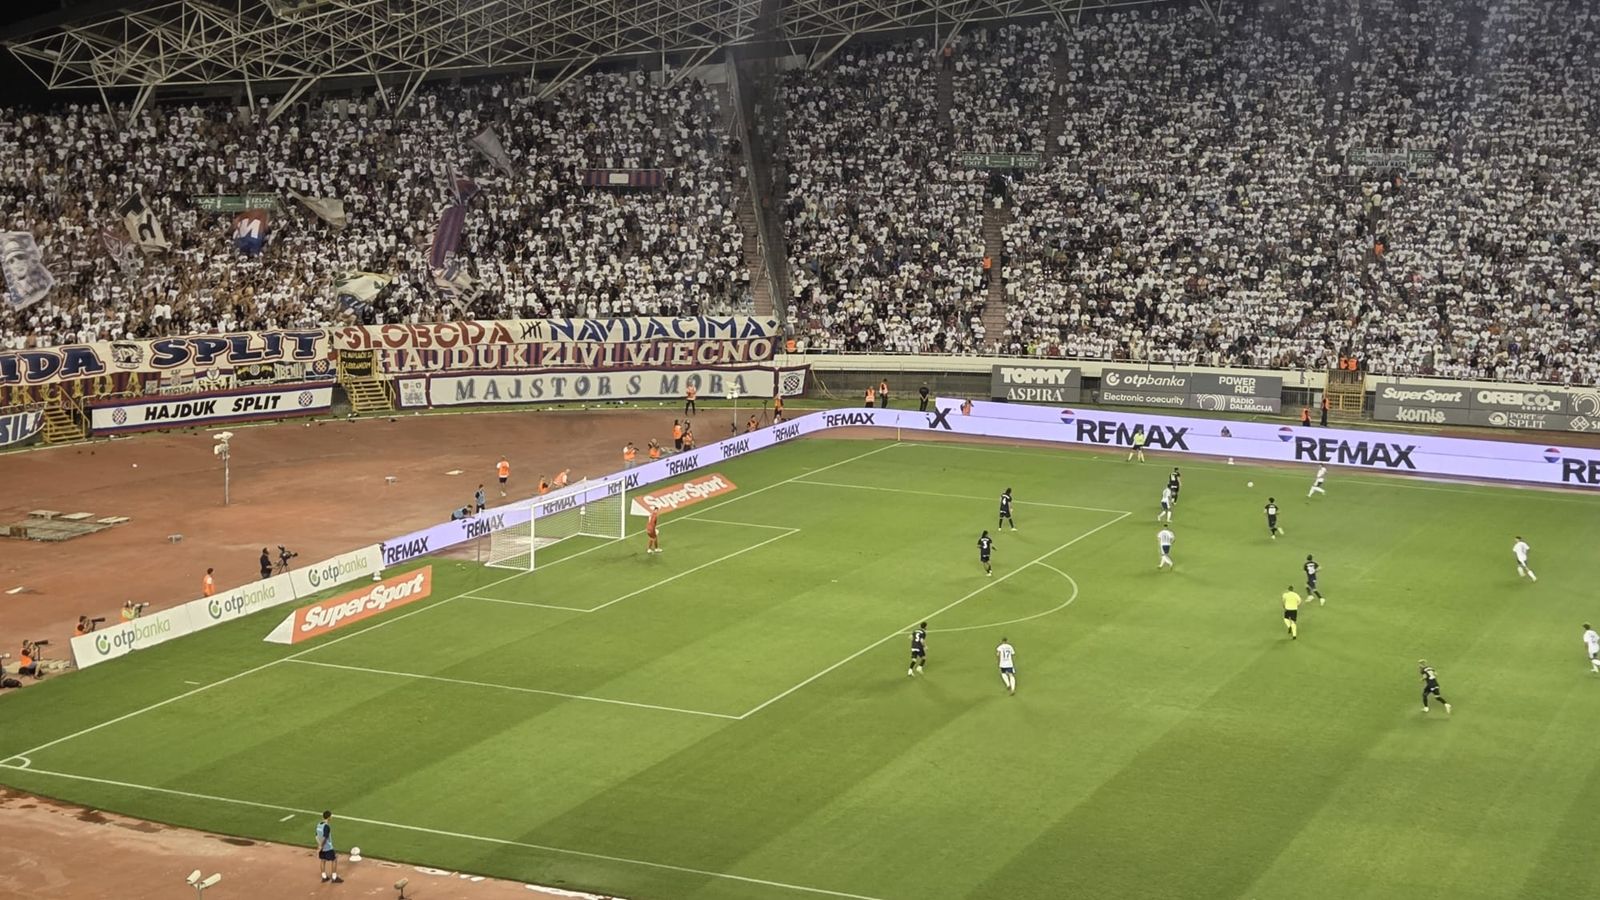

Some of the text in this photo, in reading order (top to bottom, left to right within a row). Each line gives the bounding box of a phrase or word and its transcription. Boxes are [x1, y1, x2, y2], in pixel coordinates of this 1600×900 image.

[343, 320, 514, 349] SLOBODA
[149, 330, 326, 369] SPLIT
[378, 342, 530, 373] HAJDUK
[1000, 367, 1072, 385] TOMMY
[1123, 374, 1186, 388] otpbanka
[1218, 376, 1256, 386] POWER
[1006, 387, 1064, 402] ASPIRA
[1103, 391, 1144, 403] Electronic
[1234, 384, 1256, 394] ADE
[1382, 387, 1464, 403] SuperSport
[1477, 390, 1551, 407] ORBICO
[144, 395, 282, 422] HAJDUK SPLIT
[1229, 403, 1273, 412] DALMACIJA
[1230, 396, 1255, 405] RADIO
[826, 412, 875, 427] REMAX
[1508, 419, 1546, 430] SPLIT
[1509, 411, 1537, 420] PORT
[775, 422, 800, 441] REMAX
[1076, 418, 1190, 451] REMAX
[723, 438, 750, 458] REMAX
[1295, 436, 1417, 470] REMAX
[669, 454, 699, 475] REMAX
[643, 475, 729, 511] SuperSport
[387, 535, 430, 562] REMAX
[322, 553, 368, 583] otpbanka
[224, 583, 276, 614] otpbanka
[301, 572, 425, 632] SuperSport
[113, 617, 171, 649] otpbanka
